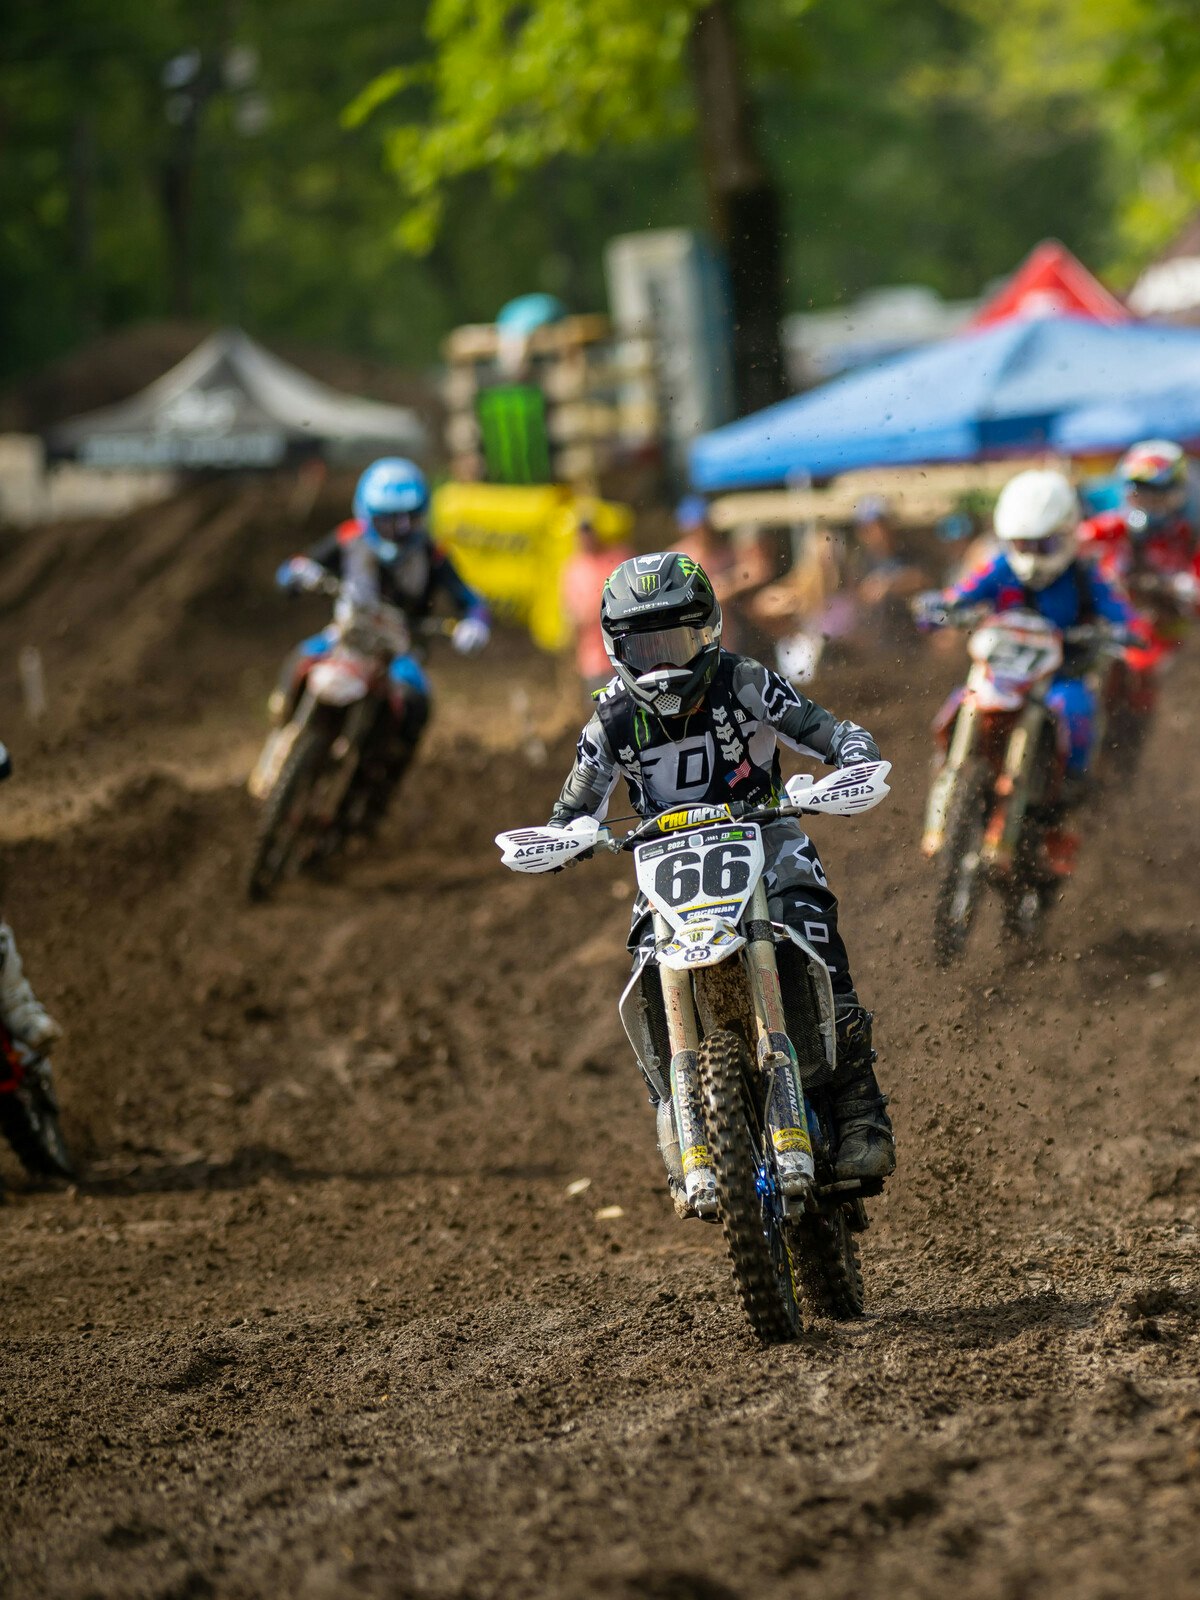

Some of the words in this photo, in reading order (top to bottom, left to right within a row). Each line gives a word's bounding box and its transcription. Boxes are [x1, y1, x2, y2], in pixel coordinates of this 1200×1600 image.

[623, 601, 670, 614] MONSTER
[667, 840, 686, 851] 2022
[655, 843, 751, 908] 66
